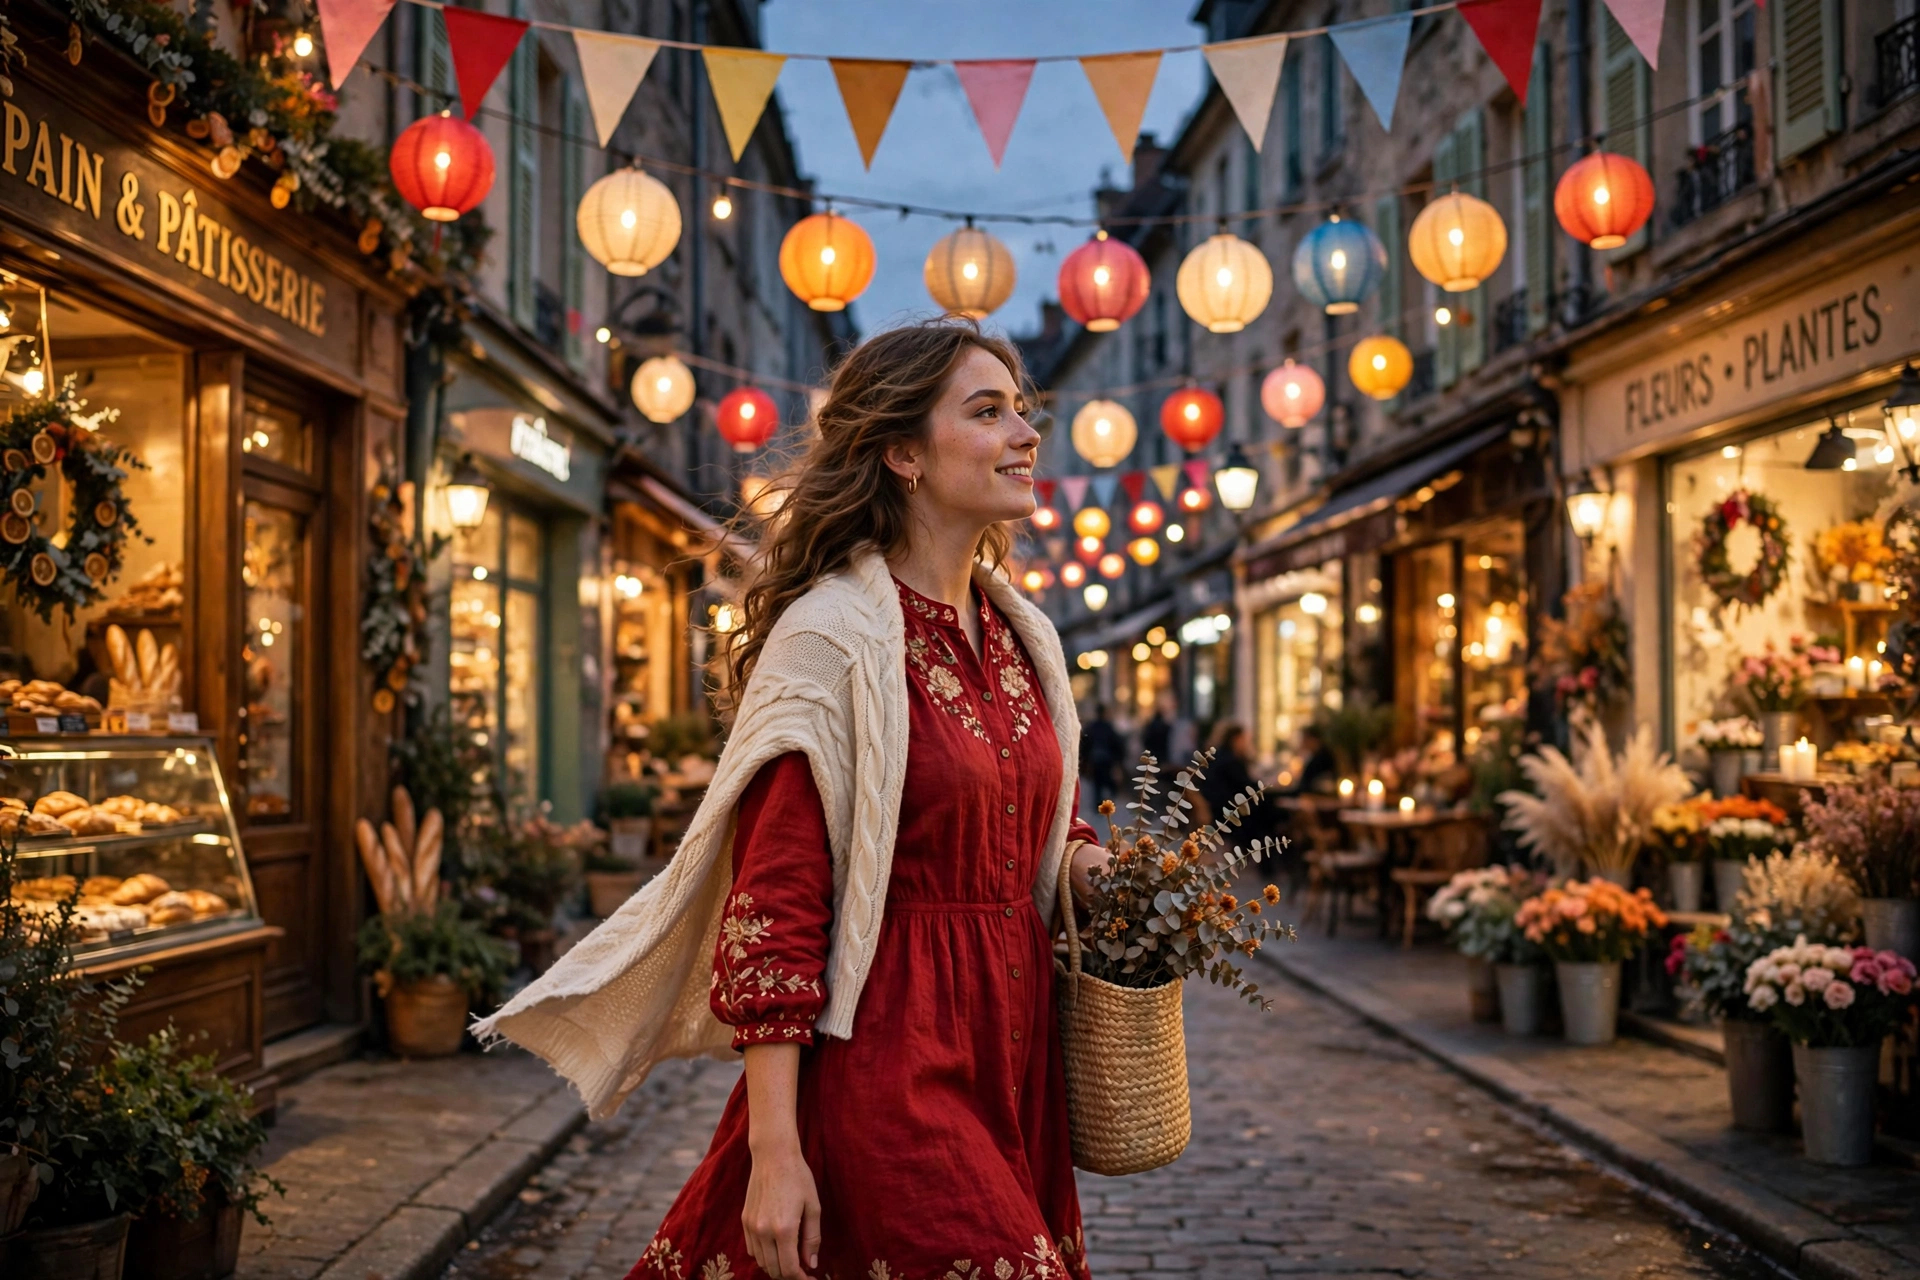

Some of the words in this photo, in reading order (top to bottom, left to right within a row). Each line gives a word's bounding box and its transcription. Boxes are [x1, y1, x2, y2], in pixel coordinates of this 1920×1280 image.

[2, 101, 104, 219] PAIN
[117, 171, 146, 240] &
[157, 188, 327, 338] PÂTISSERIE
[1626, 354, 1714, 434] FLEURS
[1744, 284, 1882, 389] PLANTES
